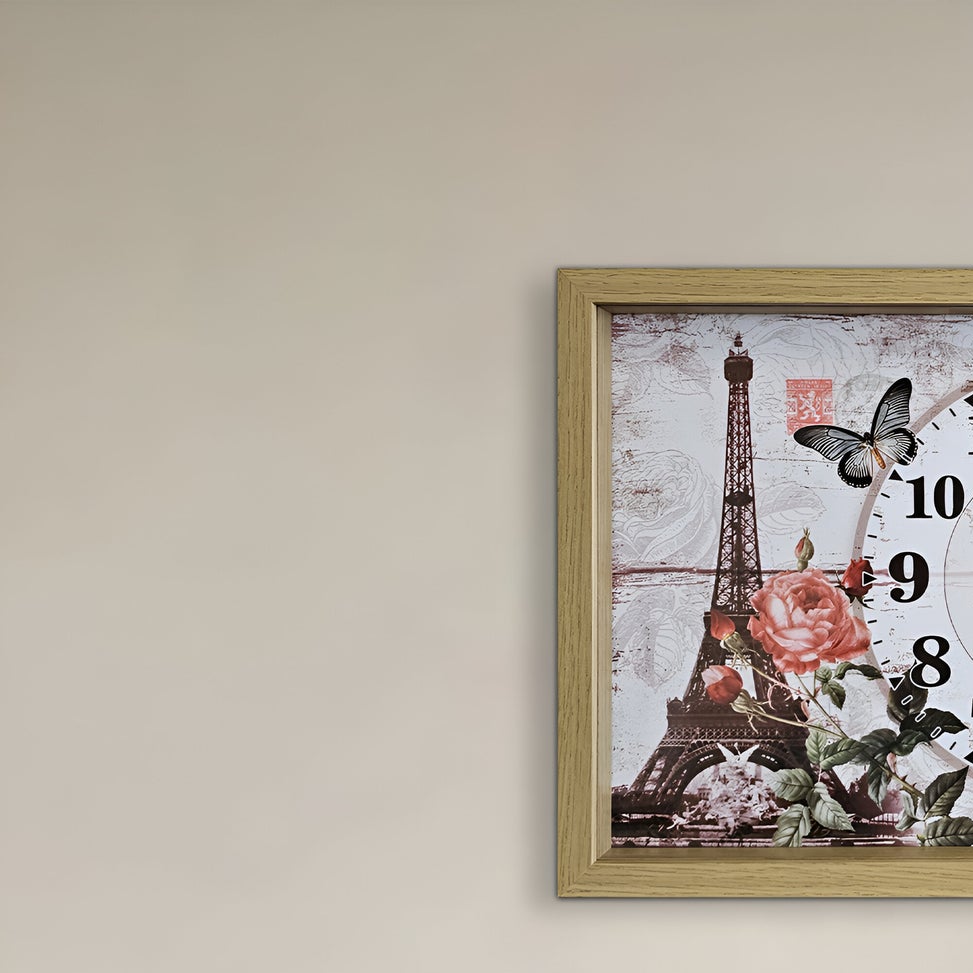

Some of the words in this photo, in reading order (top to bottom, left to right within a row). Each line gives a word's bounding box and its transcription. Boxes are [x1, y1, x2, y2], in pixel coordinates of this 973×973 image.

[905, 475, 965, 520] 10
[888, 551, 930, 603] 9
[911, 635, 952, 687] 8
